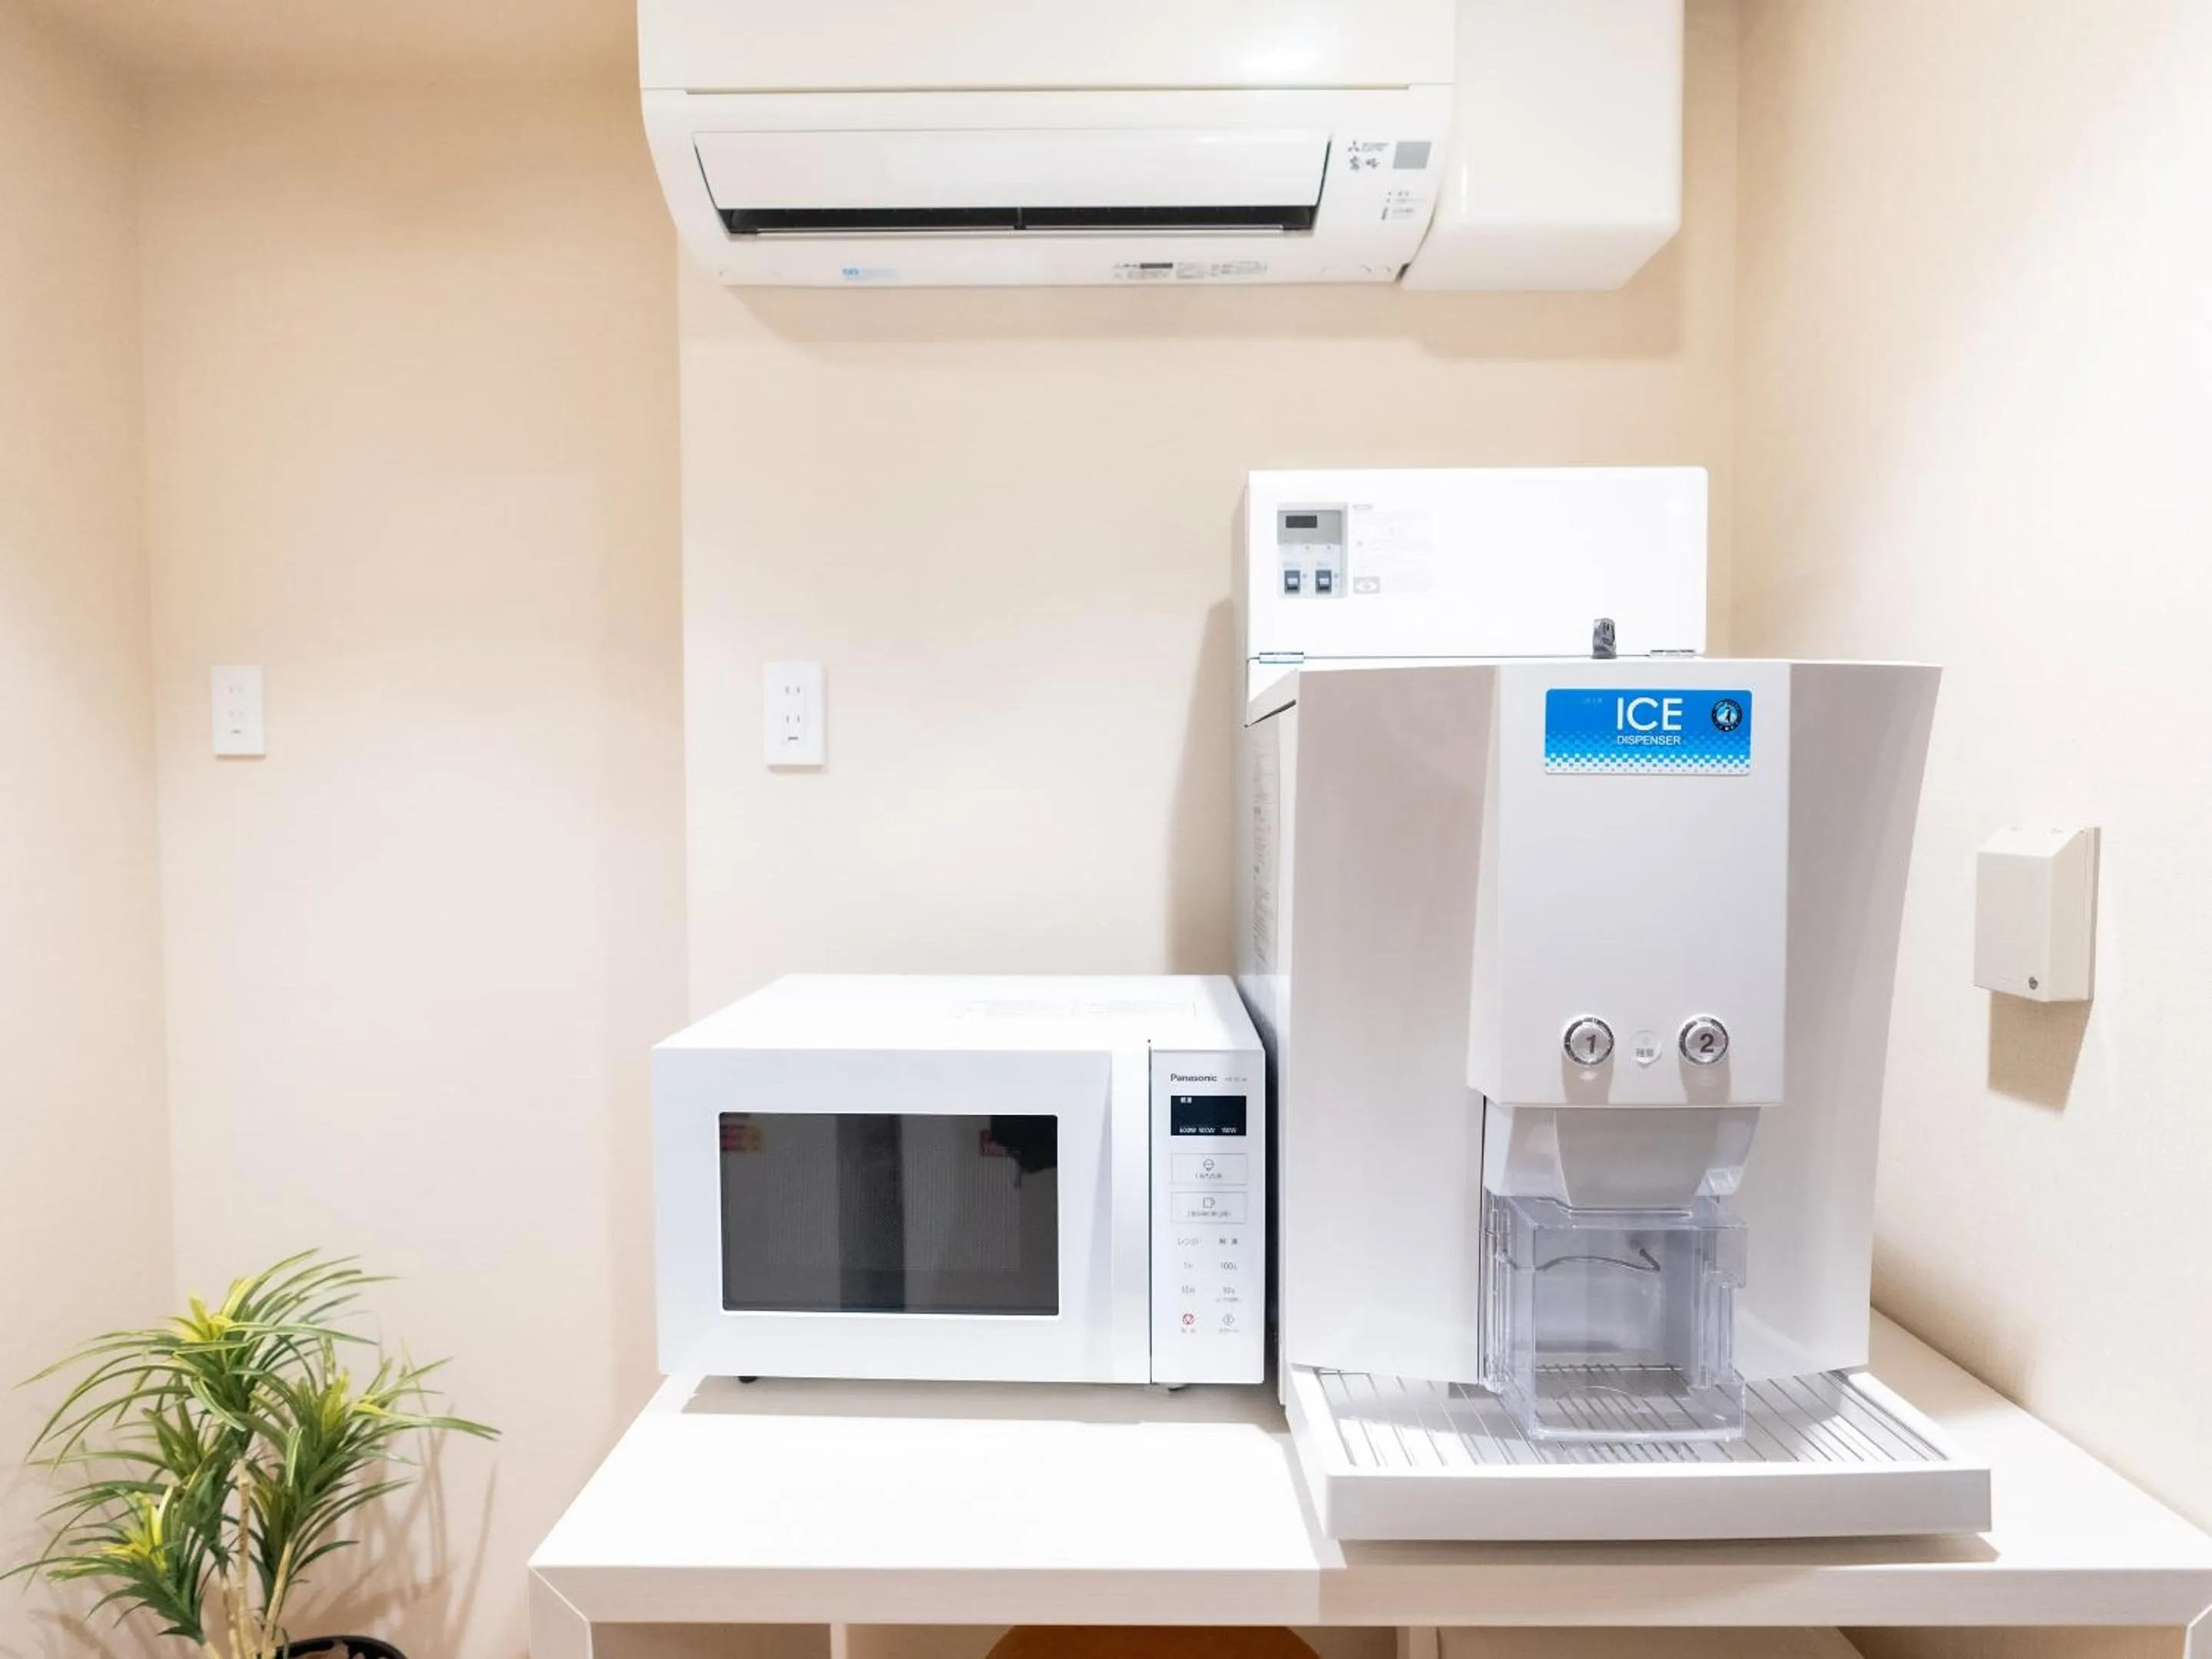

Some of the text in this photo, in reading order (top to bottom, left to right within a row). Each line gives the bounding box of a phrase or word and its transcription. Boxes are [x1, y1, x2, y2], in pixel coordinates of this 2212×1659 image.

[1617, 697, 1683, 730] ICE
[1617, 735, 1681, 745] DISPENSER
[1586, 1034, 1596, 1054] 1
[1700, 1033, 1714, 1053] 2
[1171, 1073, 1217, 1082] Panasonic
